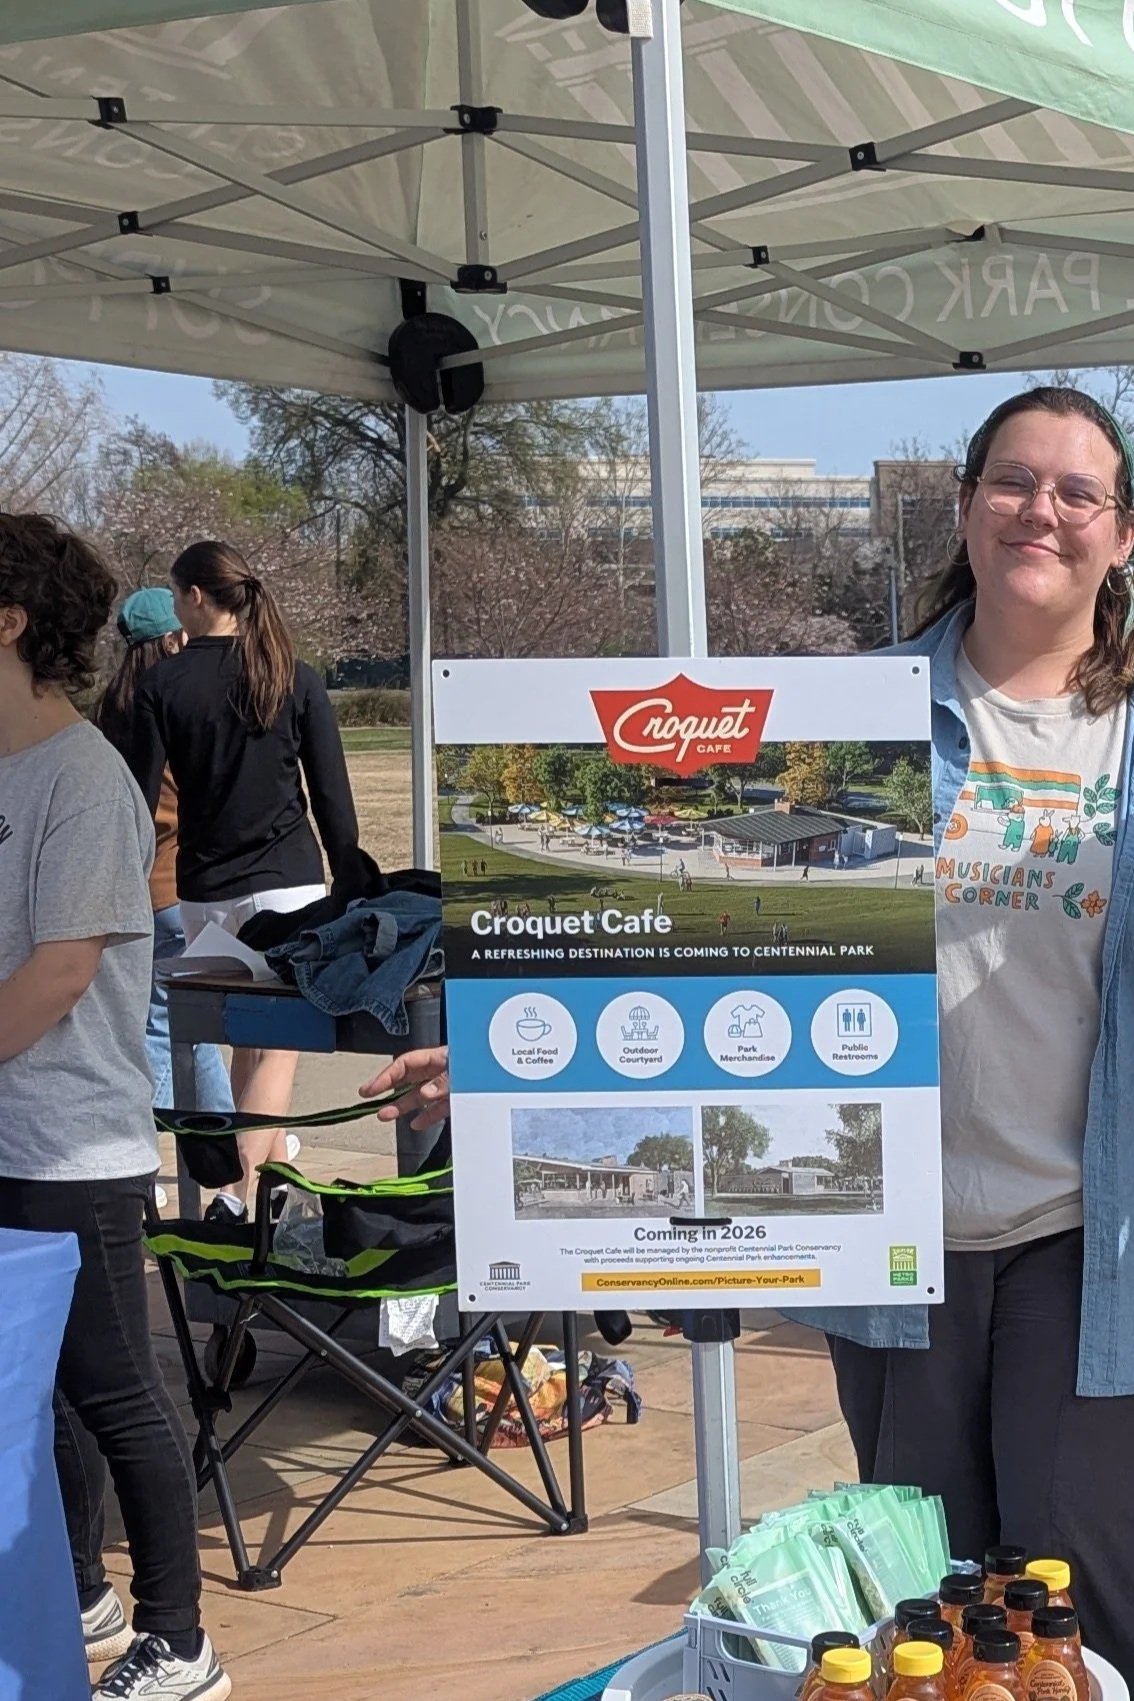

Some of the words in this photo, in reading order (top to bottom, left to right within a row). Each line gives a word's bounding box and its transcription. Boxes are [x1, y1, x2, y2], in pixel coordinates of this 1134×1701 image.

[613, 698, 756, 762] Croquet
[696, 744, 732, 753] CAFE
[935, 857, 1056, 889] MUSICIANS
[944, 883, 1040, 911] CORNER
[471, 910, 595, 940] Croquet
[601, 909, 673, 935] Cafe
[471, 949, 481, 959] A
[484, 949, 565, 959] REFRESHING
[569, 947, 655, 958] DESTINATION
[658, 947, 670, 957] IS
[673, 947, 729, 957] COMING
[732, 947, 750, 957] TO
[754, 946, 836, 957] CENTENNIAL
[840, 945, 874, 956] PARK
[512, 1048, 535, 1056] Local
[537, 1047, 558, 1055] Food
[623, 1047, 659, 1055] Outdoor
[738, 1045, 757, 1053] Park
[841, 1043, 869, 1052] Public
[517, 1057, 524, 1065] &
[525, 1056, 554, 1065] Coffee
[619, 1055, 663, 1065] Courtyard
[720, 1053, 776, 1062] Merchandise
[832, 1052, 878, 1061] Restrooms
[634, 1227, 698, 1243] Coming
[702, 1226, 717, 1240] in
[720, 1225, 767, 1240] 2026
[575, 1248, 604, 1257] Croquet
[605, 1247, 622, 1255] Cafe
[636, 1246, 645, 1254] be
[647, 1247, 680, 1256] managed
[682, 1246, 690, 1256] by
[704, 1245, 737, 1254] nonprofit
[778, 1244, 794, 1252] Park
[795, 1244, 842, 1252] Conservancy
[601, 1256, 633, 1265] proceeds
[635, 1255, 674, 1265] supporting
[676, 1255, 704, 1264] ongoing
[706, 1254, 744, 1262] Centennial
[596, 1275, 805, 1288] ConservancyOnline.com/Picture-Your-Park
[740, 1570, 758, 1586] full
[730, 1575, 752, 1605] circle
